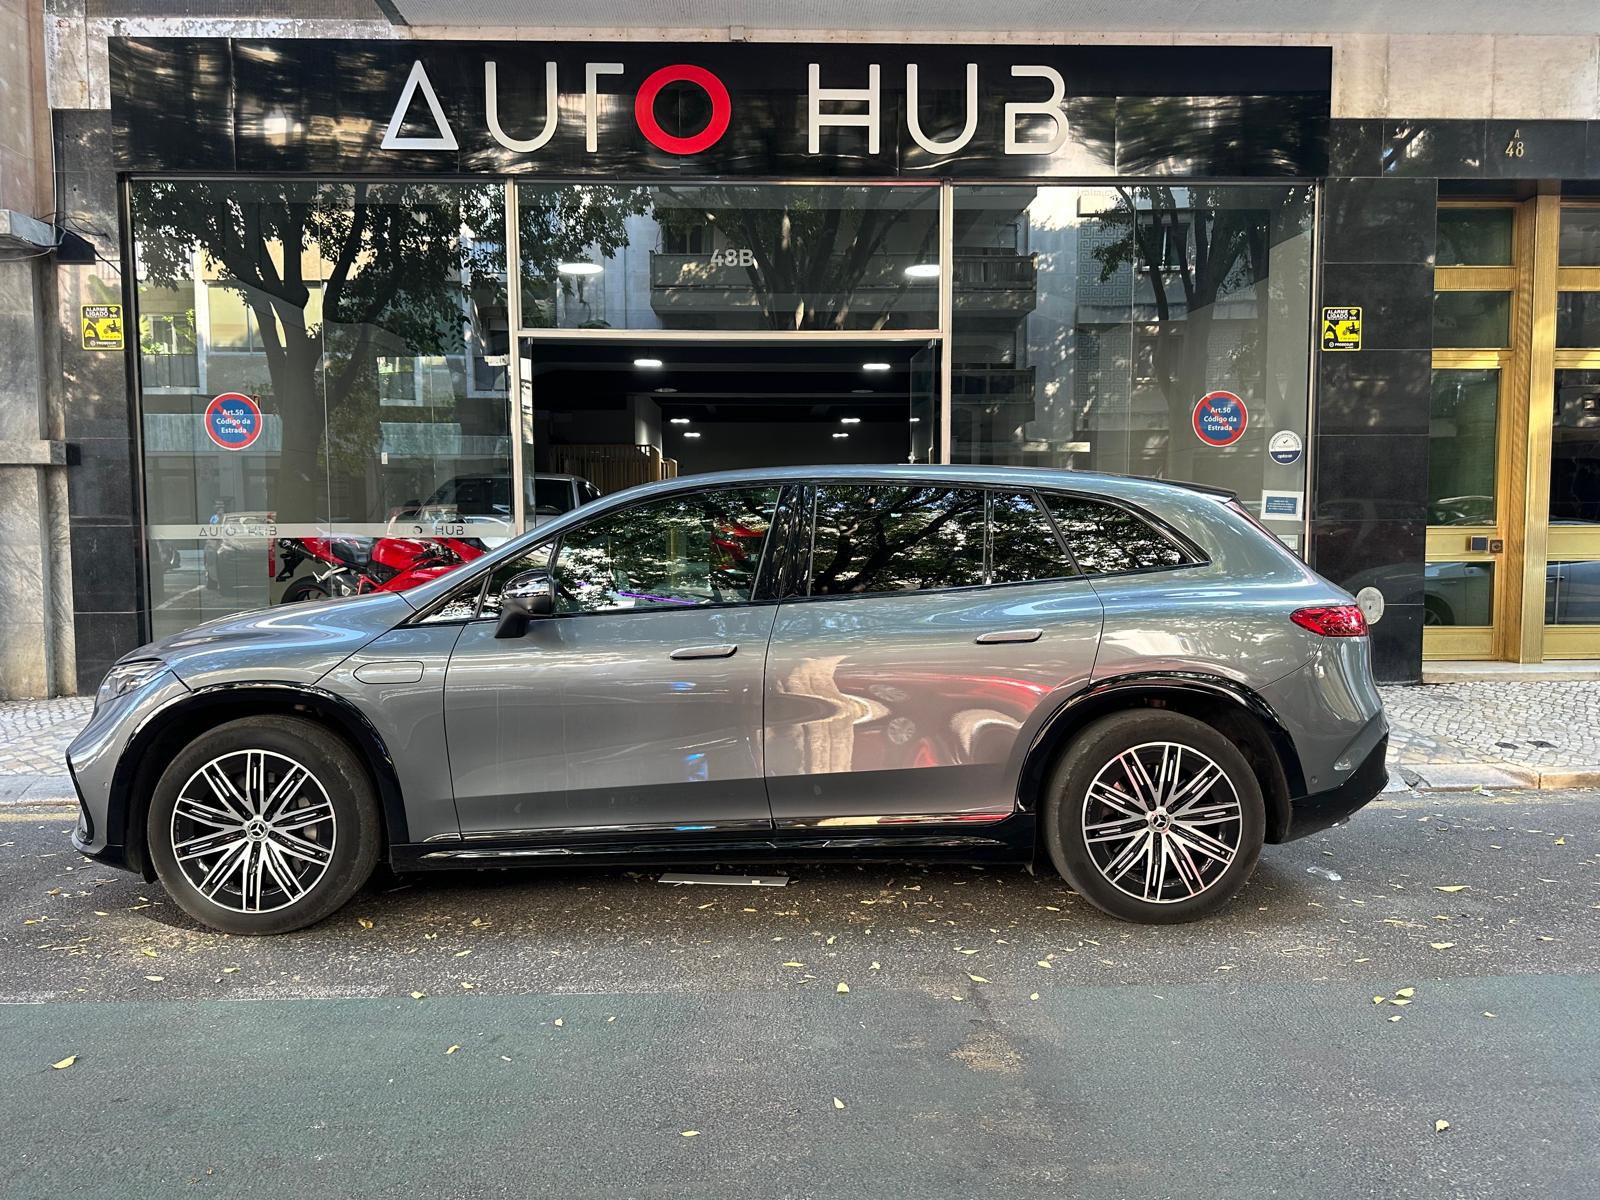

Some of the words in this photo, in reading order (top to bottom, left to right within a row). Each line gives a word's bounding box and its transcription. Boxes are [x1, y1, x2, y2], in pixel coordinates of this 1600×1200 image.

[807, 62, 1068, 156] HUB
[1505, 141, 1524, 157] 48
[710, 248, 754, 267] 48B
[216, 418, 241, 426] Código
[1203, 415, 1227, 423] Código
[221, 426, 247, 434] Estrada
